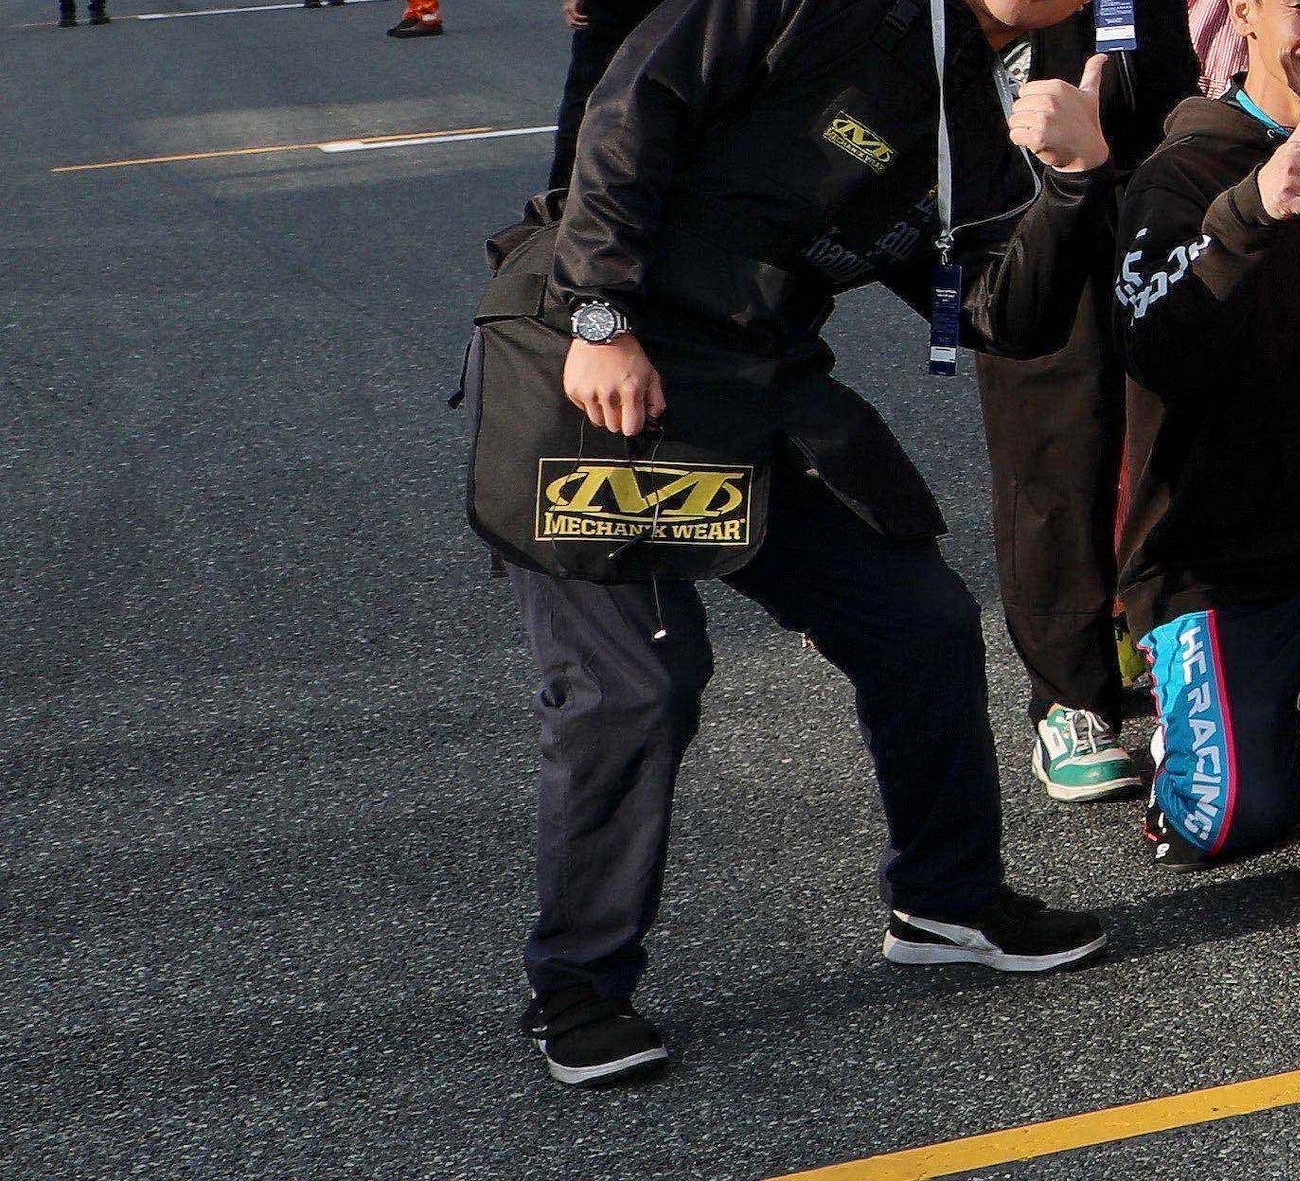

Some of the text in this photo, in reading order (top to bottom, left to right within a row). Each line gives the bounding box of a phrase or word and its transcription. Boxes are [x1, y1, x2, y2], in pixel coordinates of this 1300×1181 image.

[543, 511, 741, 540] MECHANX WEAR
[1179, 625, 1208, 686] HC
